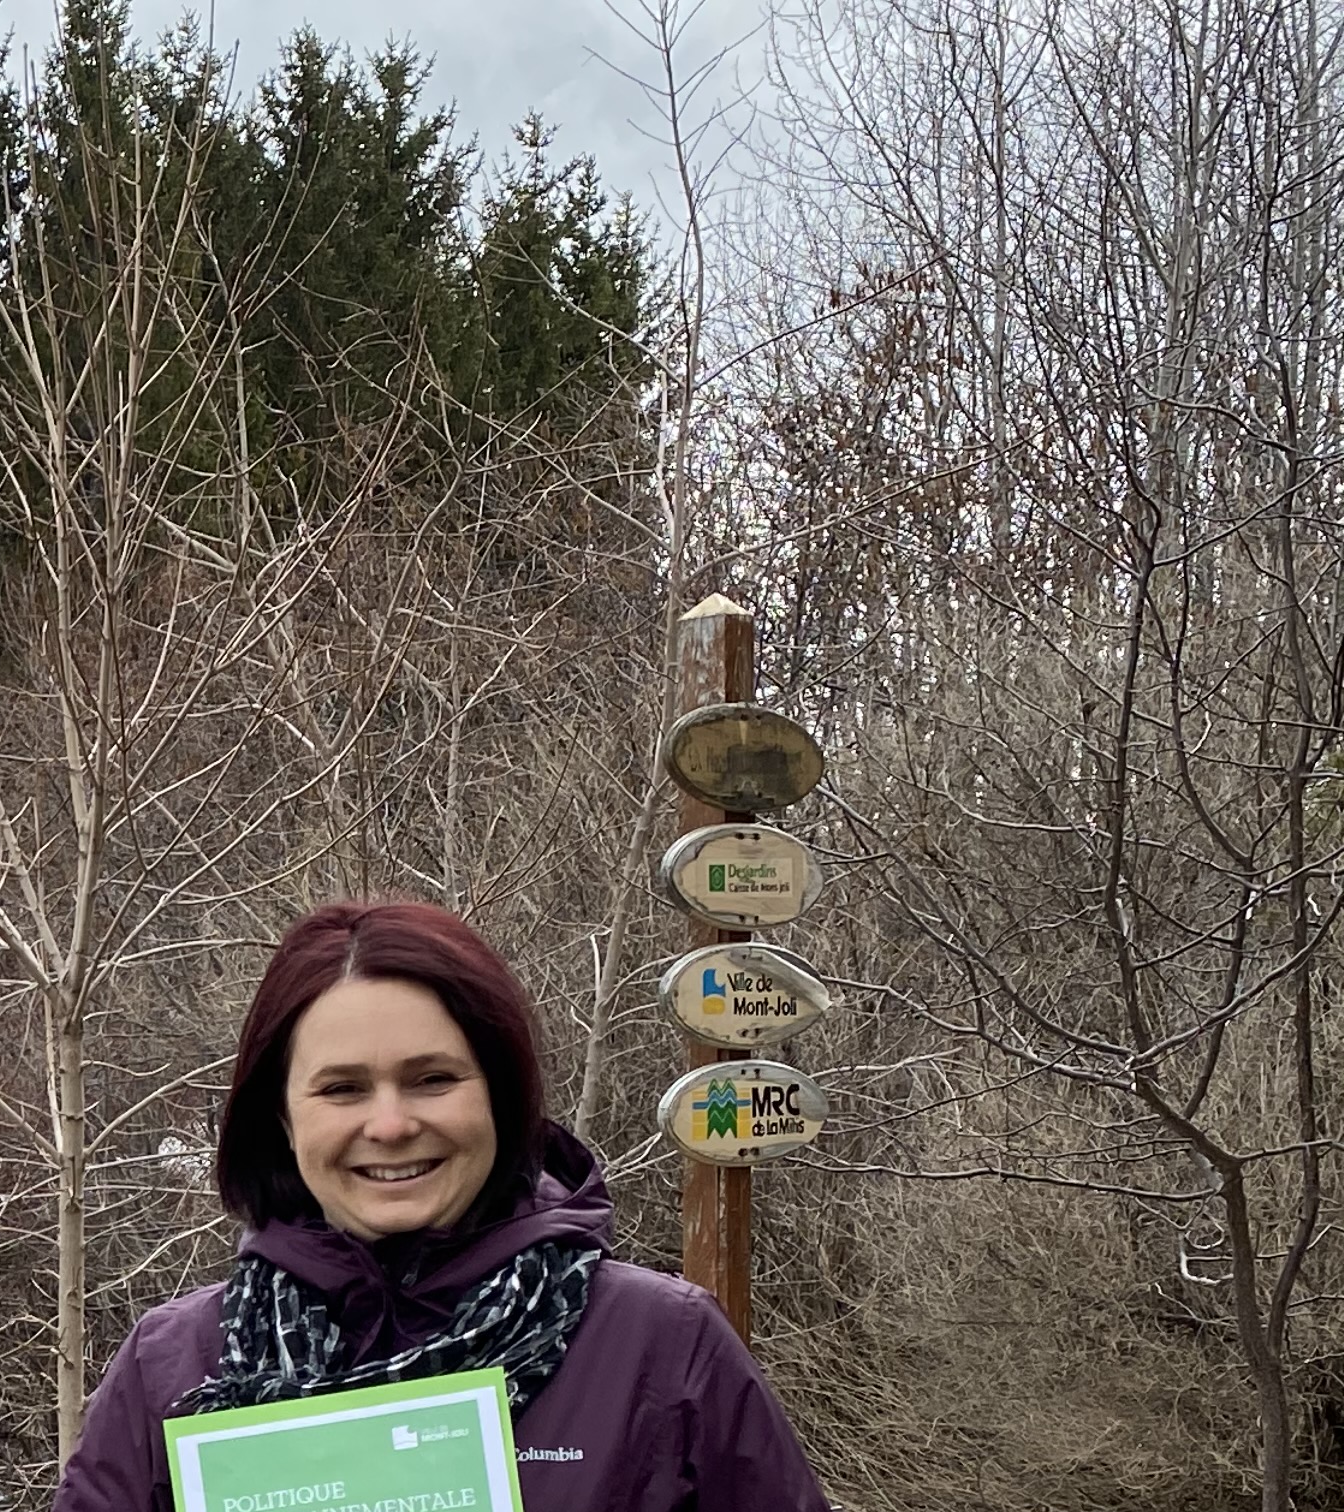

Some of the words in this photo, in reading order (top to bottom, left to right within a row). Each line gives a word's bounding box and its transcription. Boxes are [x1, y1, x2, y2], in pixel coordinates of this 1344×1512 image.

[728, 864, 777, 882] Desjardins
[727, 971, 753, 992] Ville
[755, 973, 773, 993] de
[733, 995, 798, 1017] Mont-Joli
[751, 1084, 800, 1119] MRC
[752, 1120, 765, 1137] de
